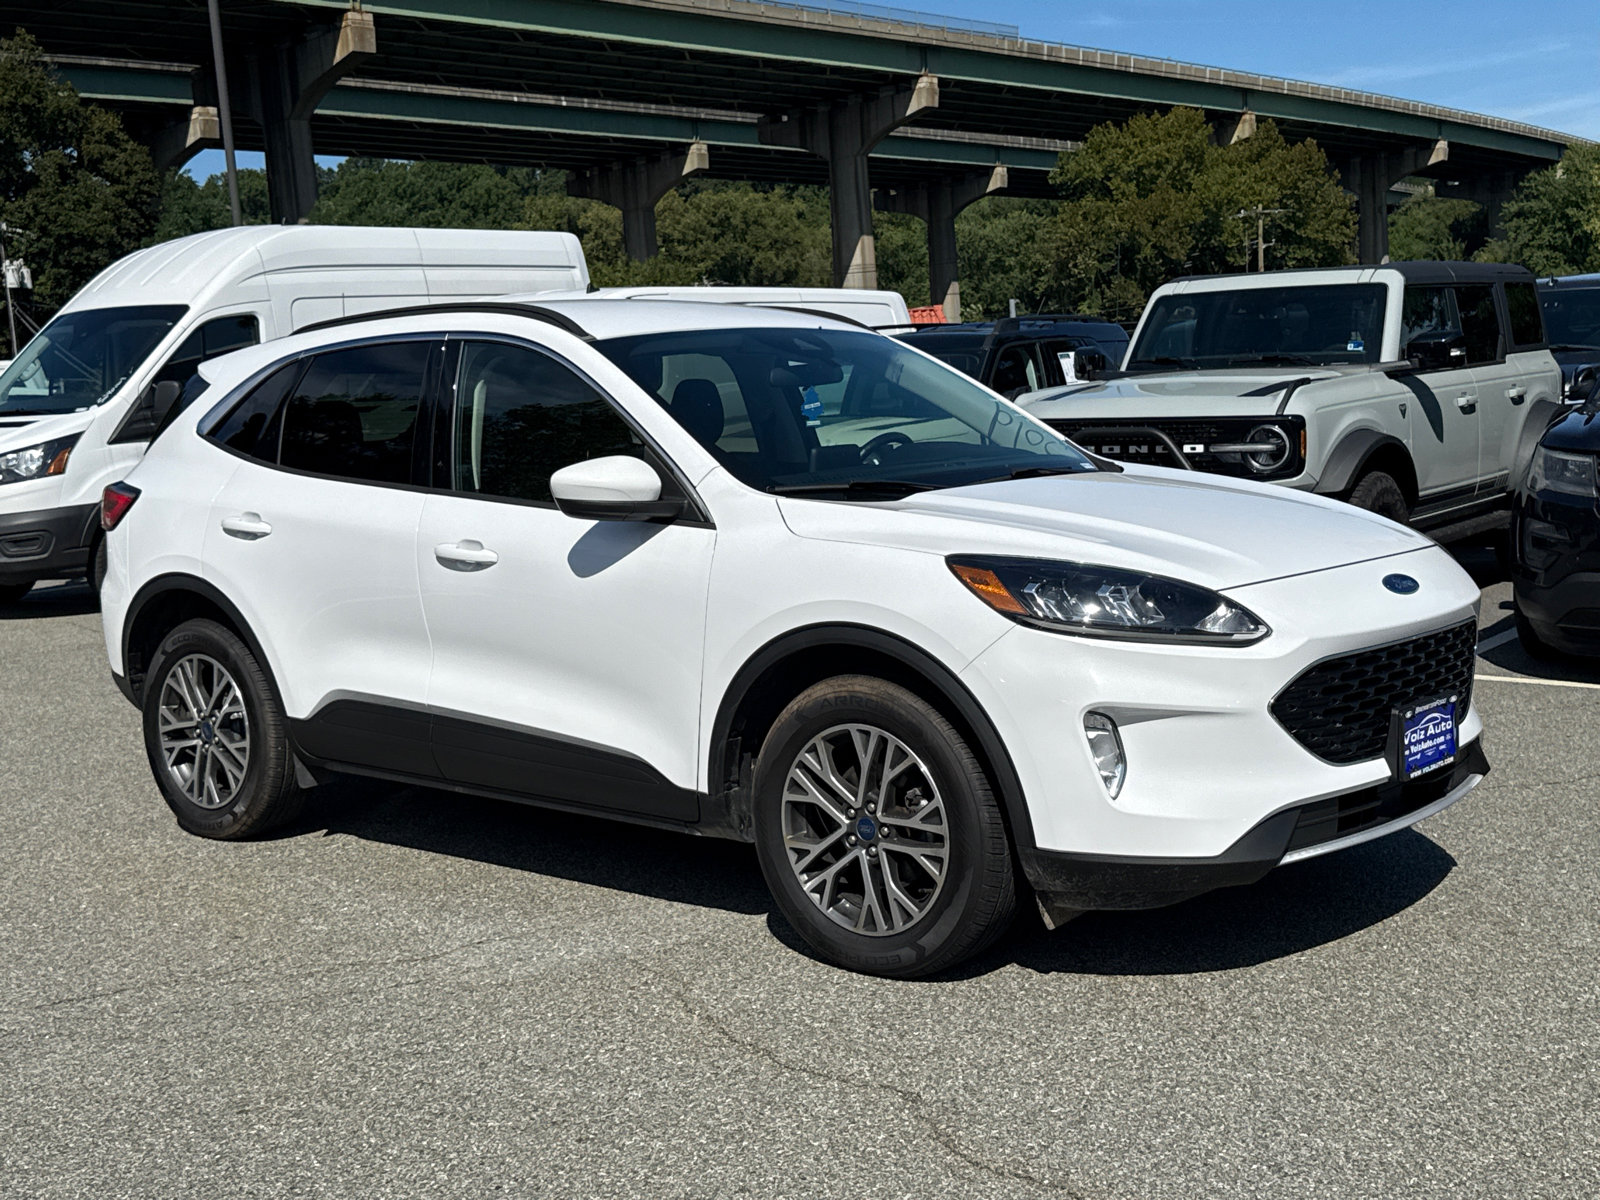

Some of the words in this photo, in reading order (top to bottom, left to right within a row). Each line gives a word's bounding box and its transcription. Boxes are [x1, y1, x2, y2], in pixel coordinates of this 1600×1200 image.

[1404, 728, 1425, 745] Volz
[1427, 720, 1452, 737] Auto
[1410, 735, 1445, 753] VolzAuto.com
